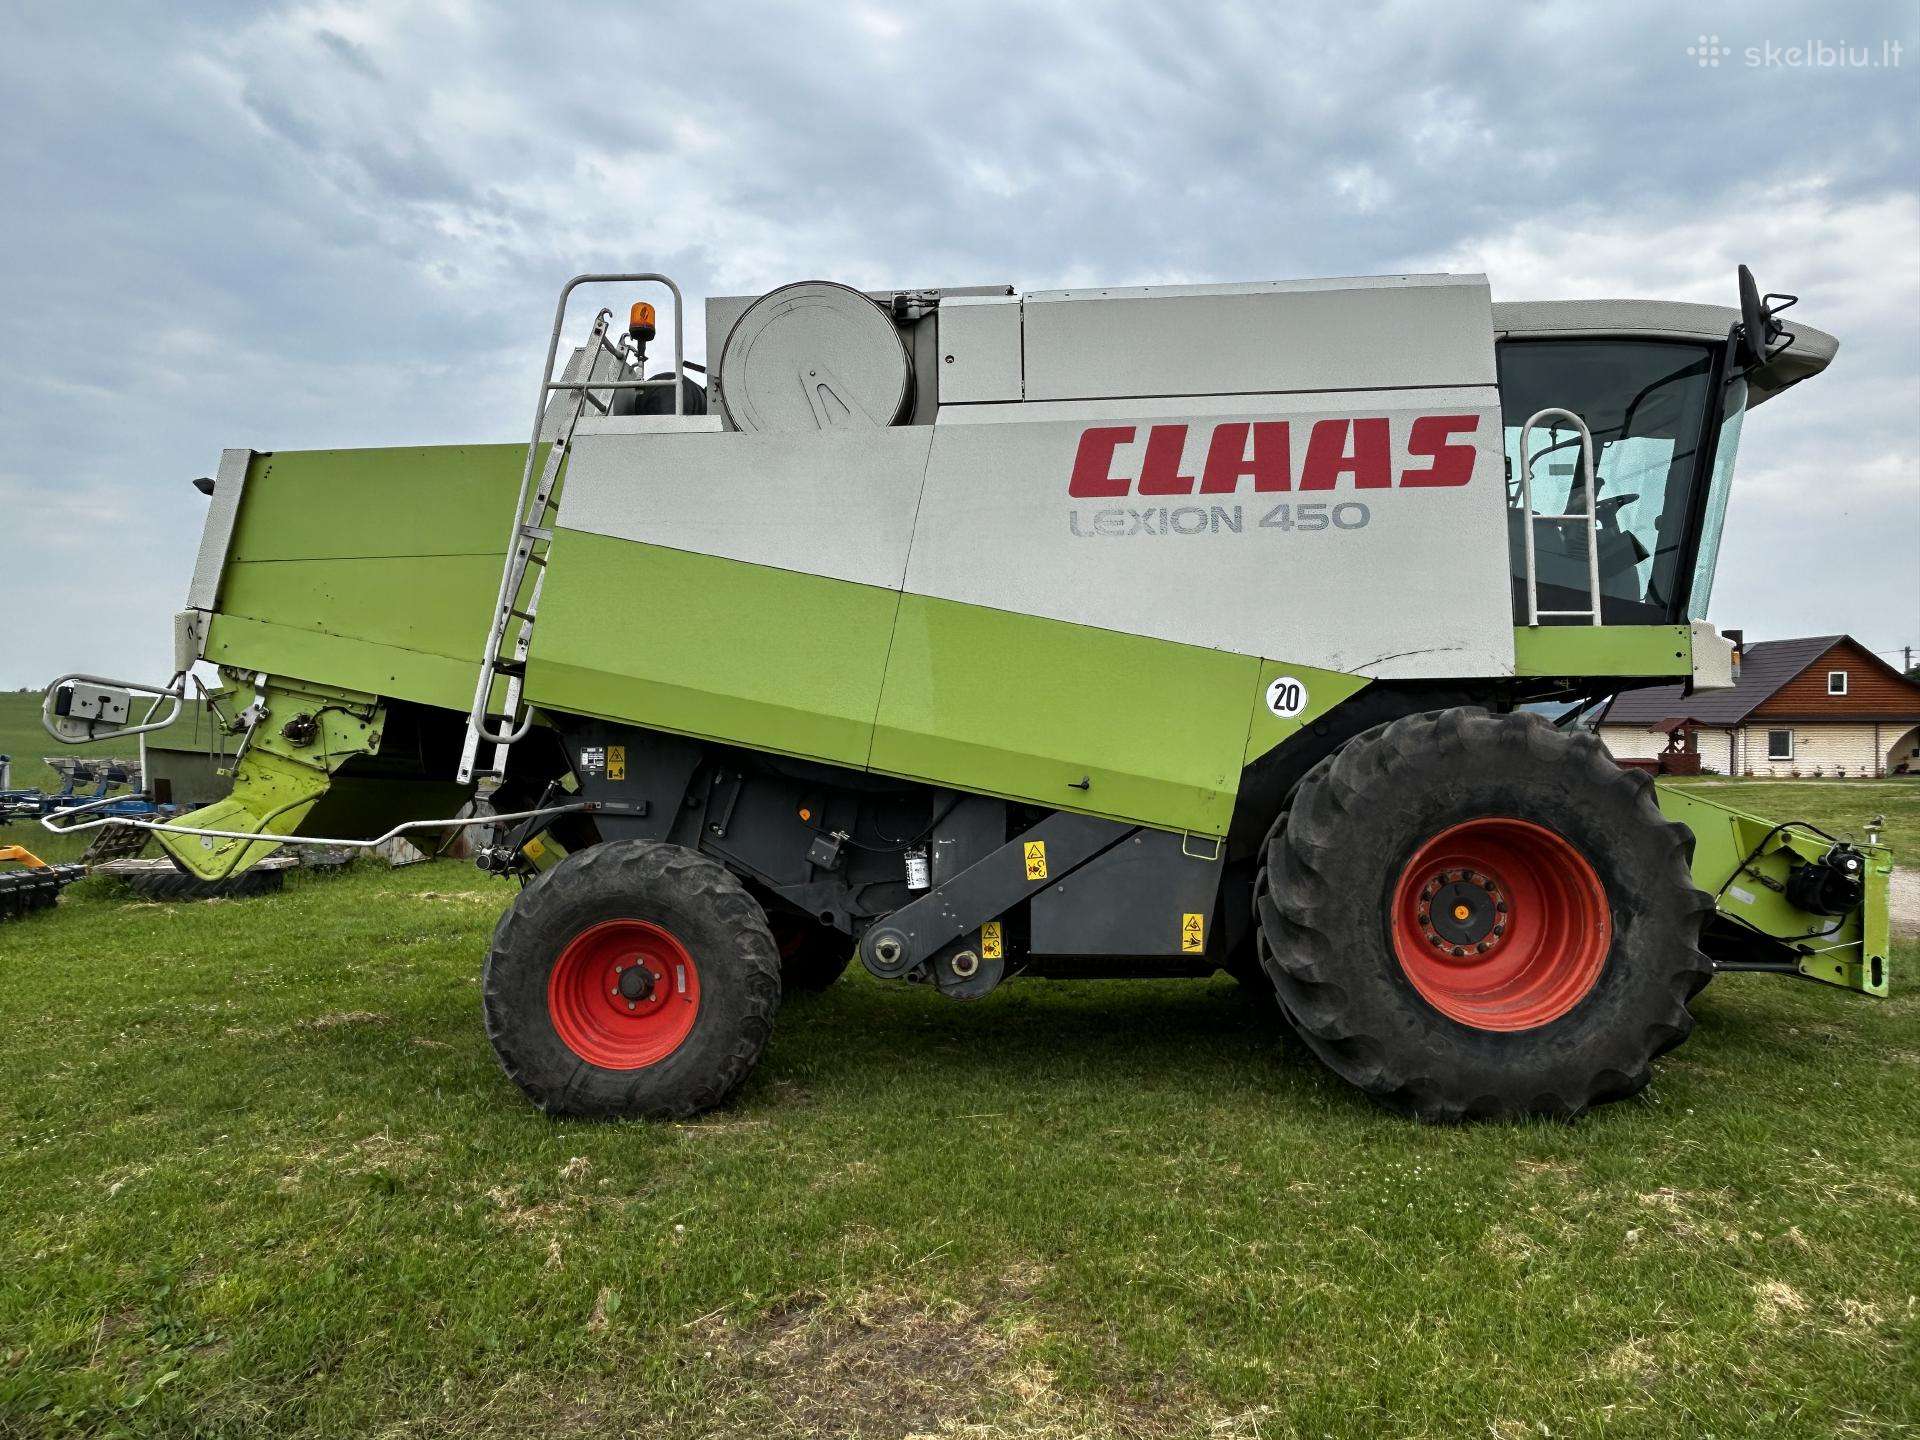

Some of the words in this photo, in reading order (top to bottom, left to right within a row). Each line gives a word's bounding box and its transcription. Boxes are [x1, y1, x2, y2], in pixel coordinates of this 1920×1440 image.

[1068, 414, 1480, 499] CLAAS
[1069, 505, 1244, 538] LEXION
[1258, 502, 1372, 533] 450
[1273, 683, 1301, 712] 20
